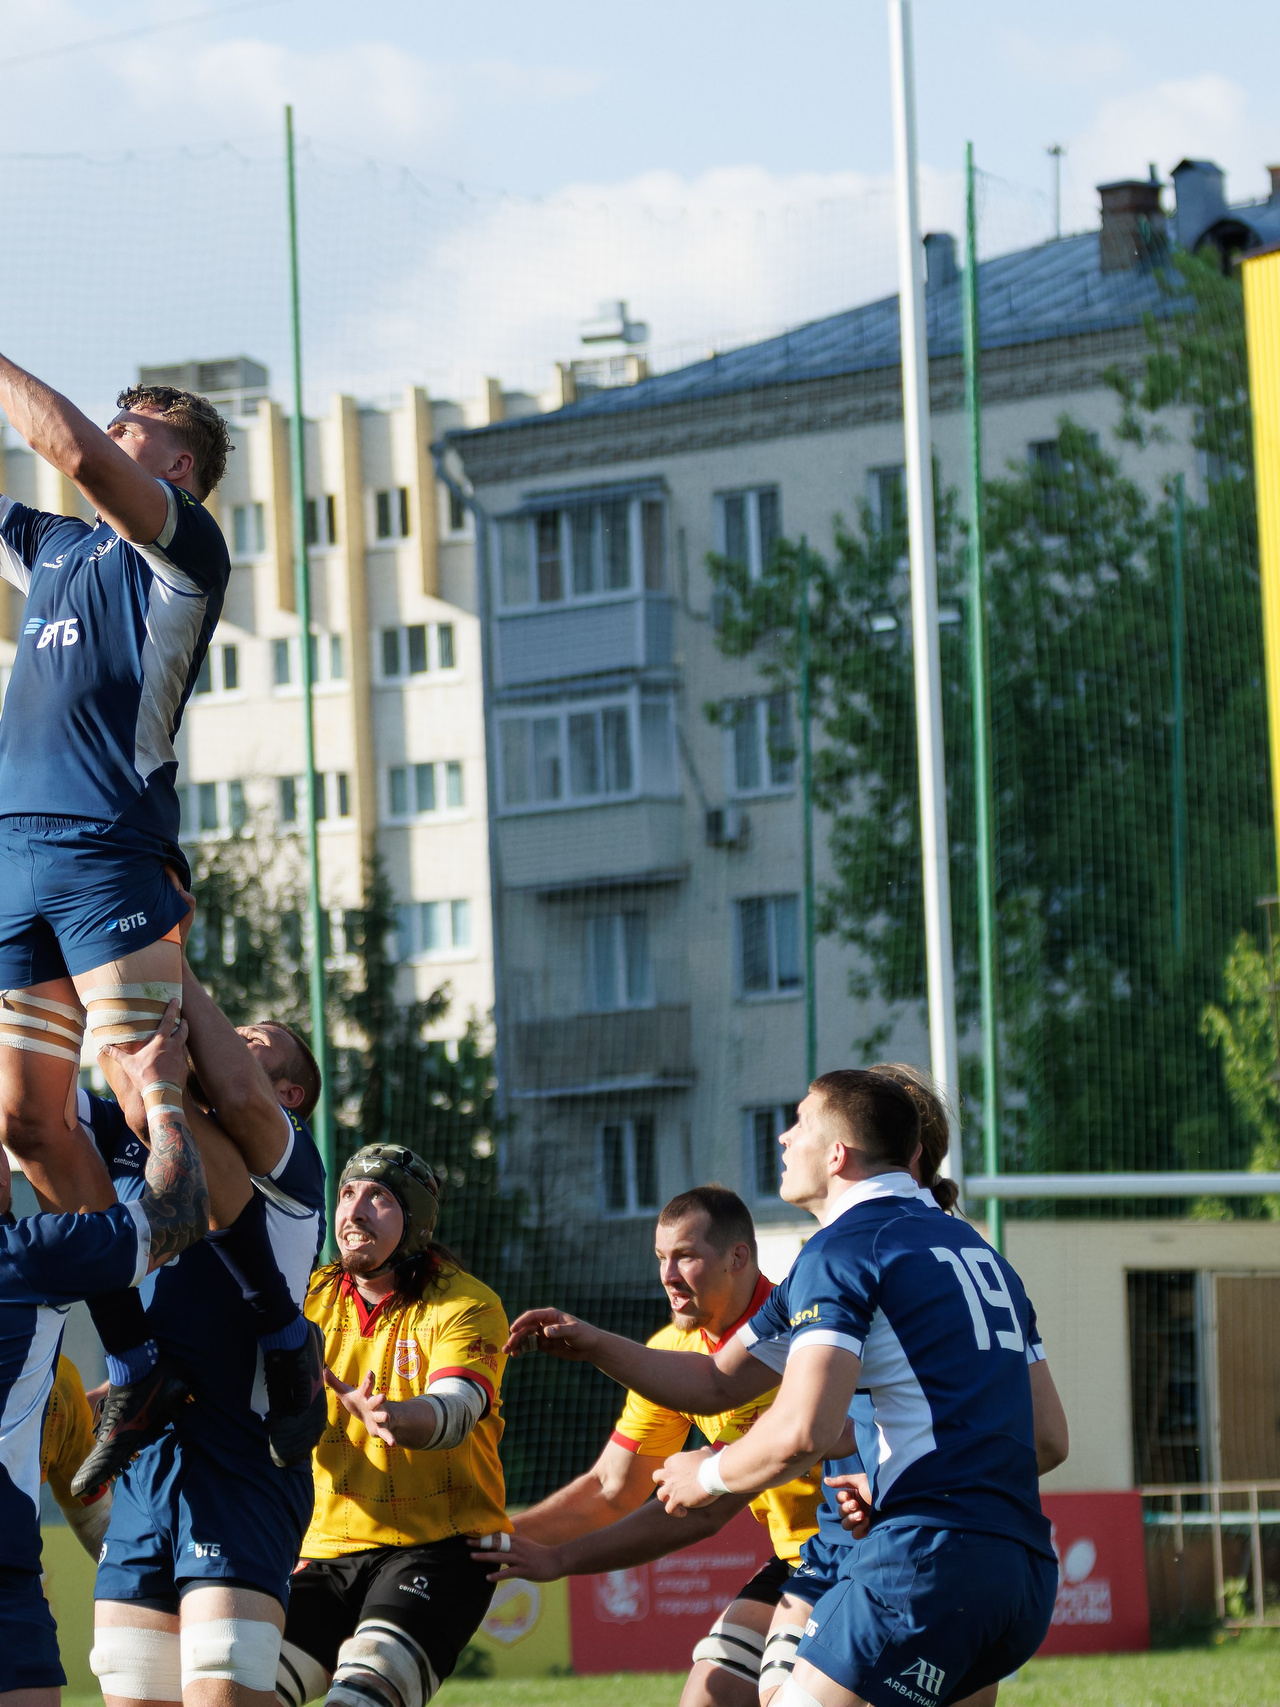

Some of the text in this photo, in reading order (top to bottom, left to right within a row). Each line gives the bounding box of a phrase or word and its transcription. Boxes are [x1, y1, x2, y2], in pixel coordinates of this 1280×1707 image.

[36, 618, 79, 649] ВТБ
[119, 911, 147, 933] ВТБ
[113, 1157, 140, 1169] centurion
[929, 1247, 1024, 1352] 19
[398, 1584, 431, 1601] centurion
